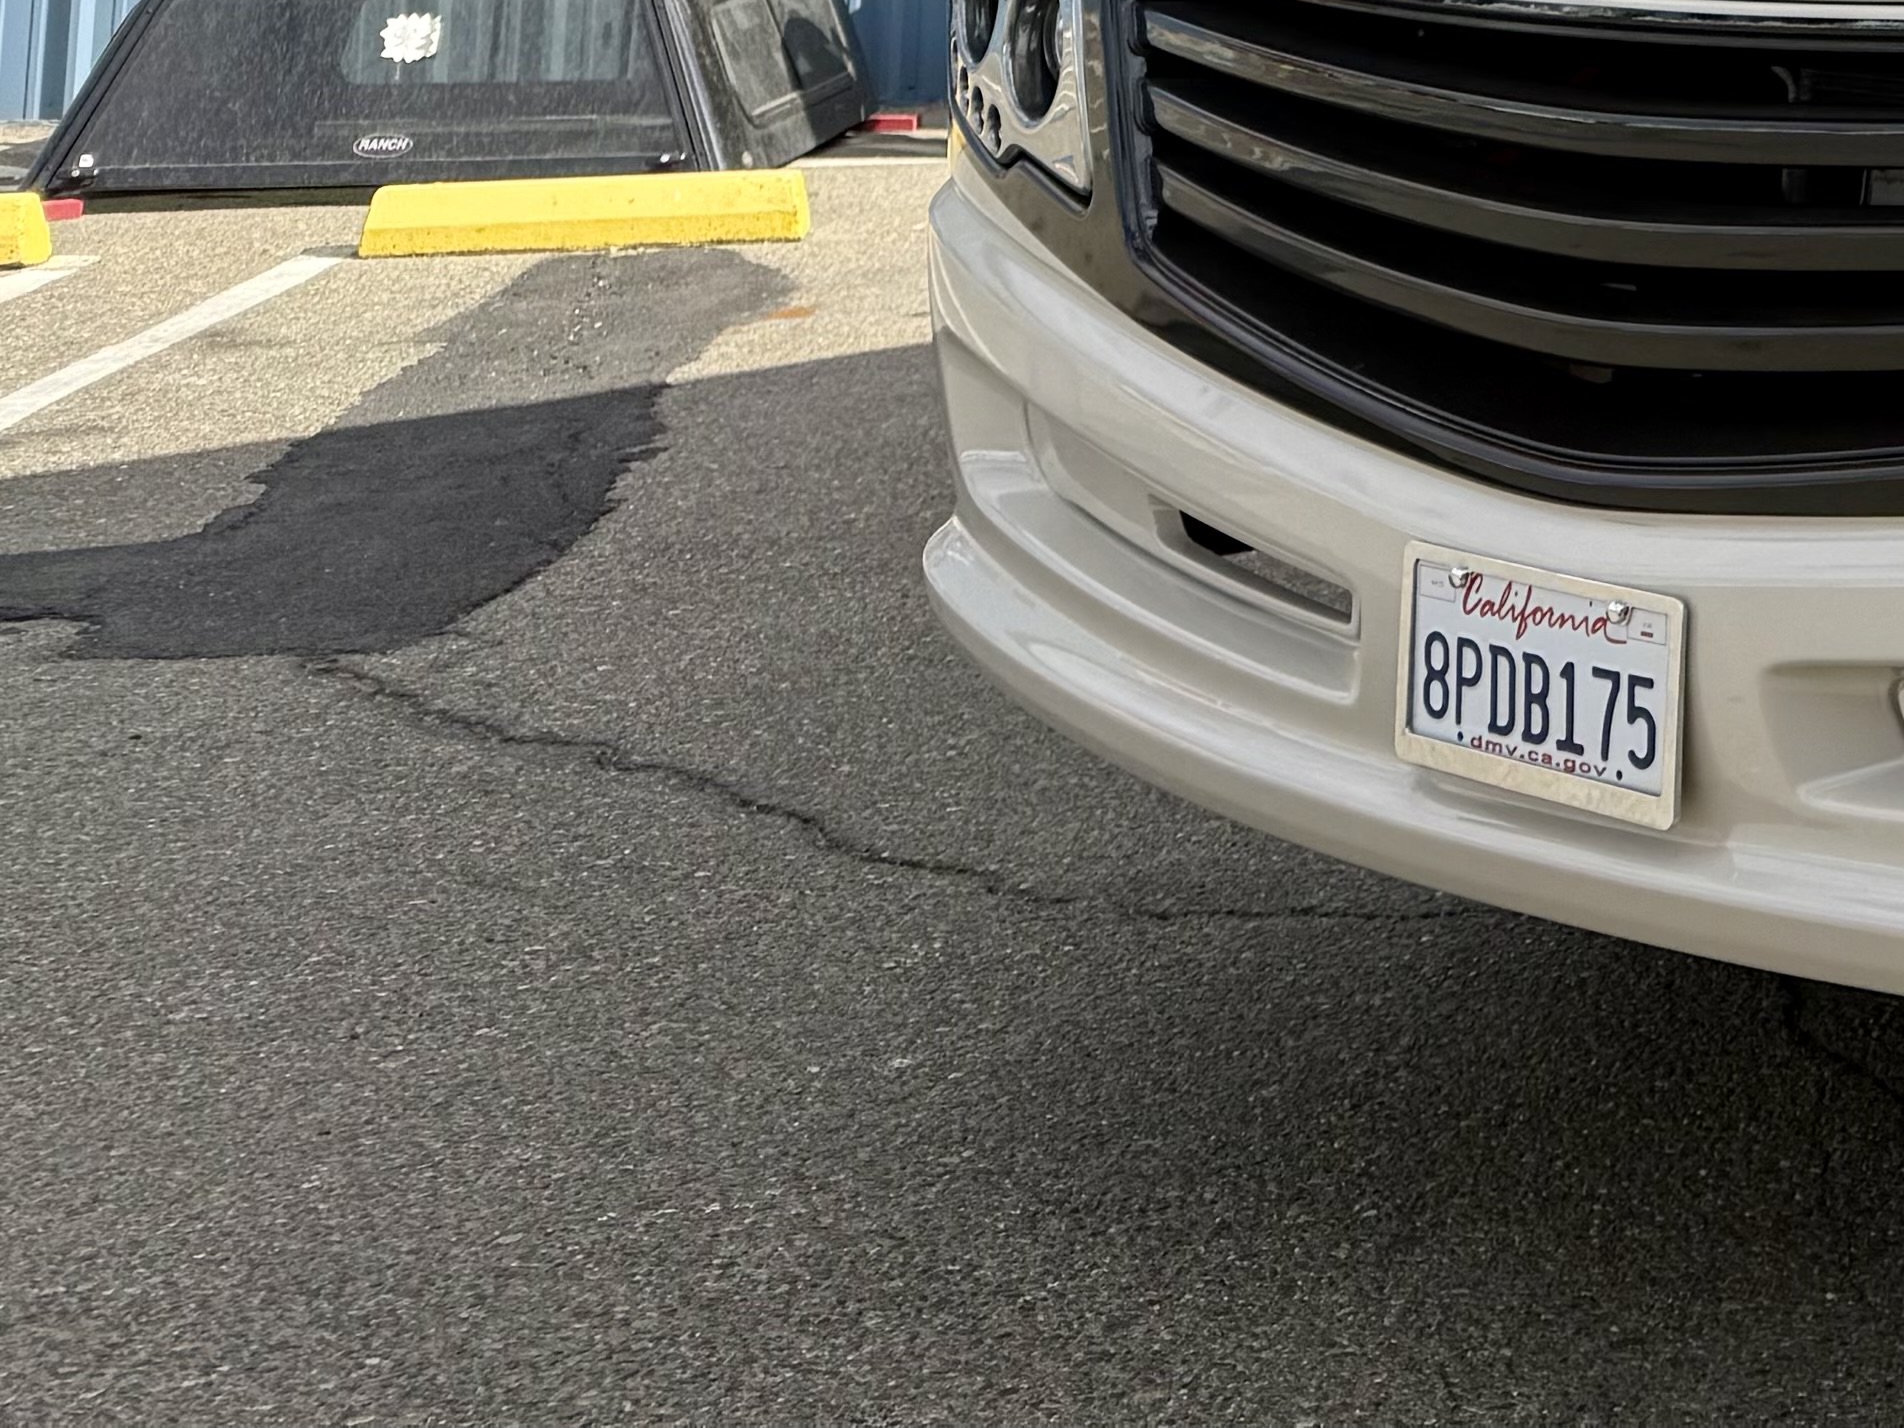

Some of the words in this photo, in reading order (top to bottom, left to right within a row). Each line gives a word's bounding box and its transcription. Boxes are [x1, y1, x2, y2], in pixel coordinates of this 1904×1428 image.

[1461, 571, 1628, 644] California
[1422, 630, 1657, 771] 8PDB175
[1470, 735, 1608, 778] dmv.ca.gov
